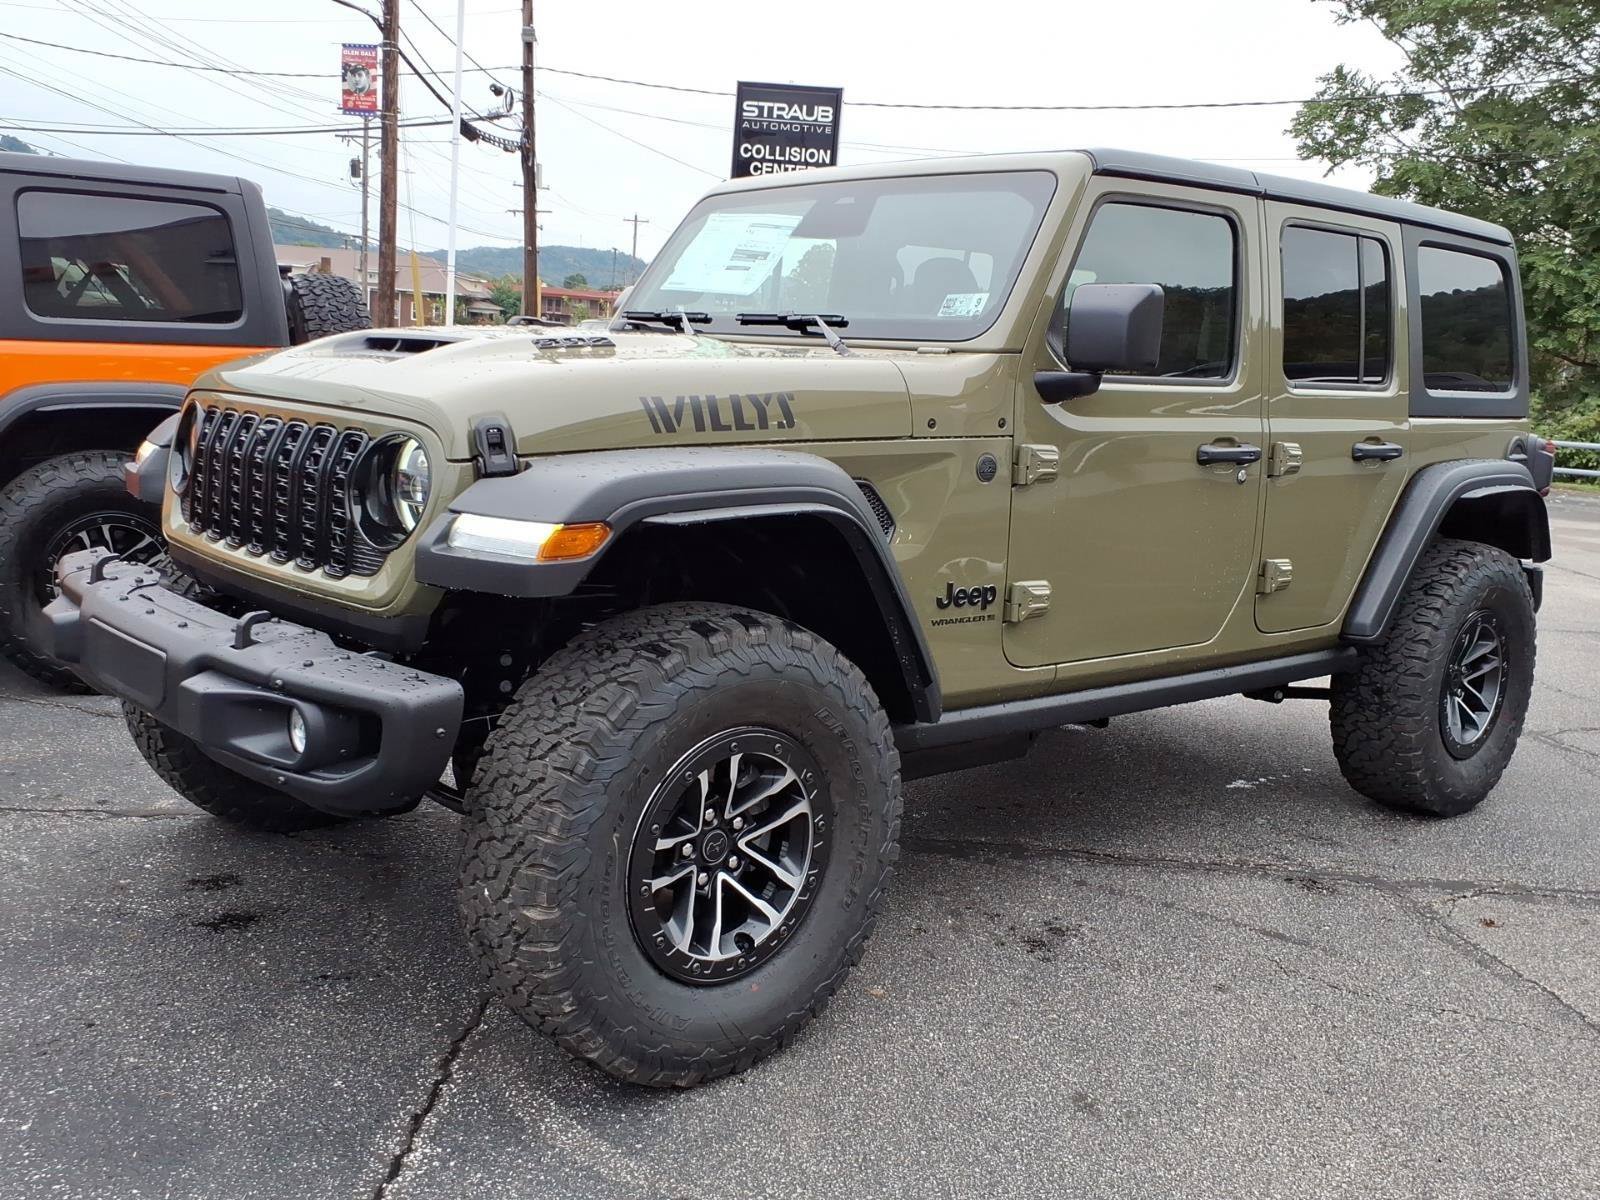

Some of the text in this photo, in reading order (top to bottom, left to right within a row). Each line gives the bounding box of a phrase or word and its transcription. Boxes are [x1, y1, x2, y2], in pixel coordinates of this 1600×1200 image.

[742, 101, 833, 122] STRAUB
[742, 121, 832, 134] AUTOMOTIVE
[740, 143, 831, 164] COLLISION
[749, 161, 817, 176] CENT
[638, 393, 796, 434] WILLYS
[936, 580, 997, 611] Jeep
[930, 614, 986, 627] WRANGLER
